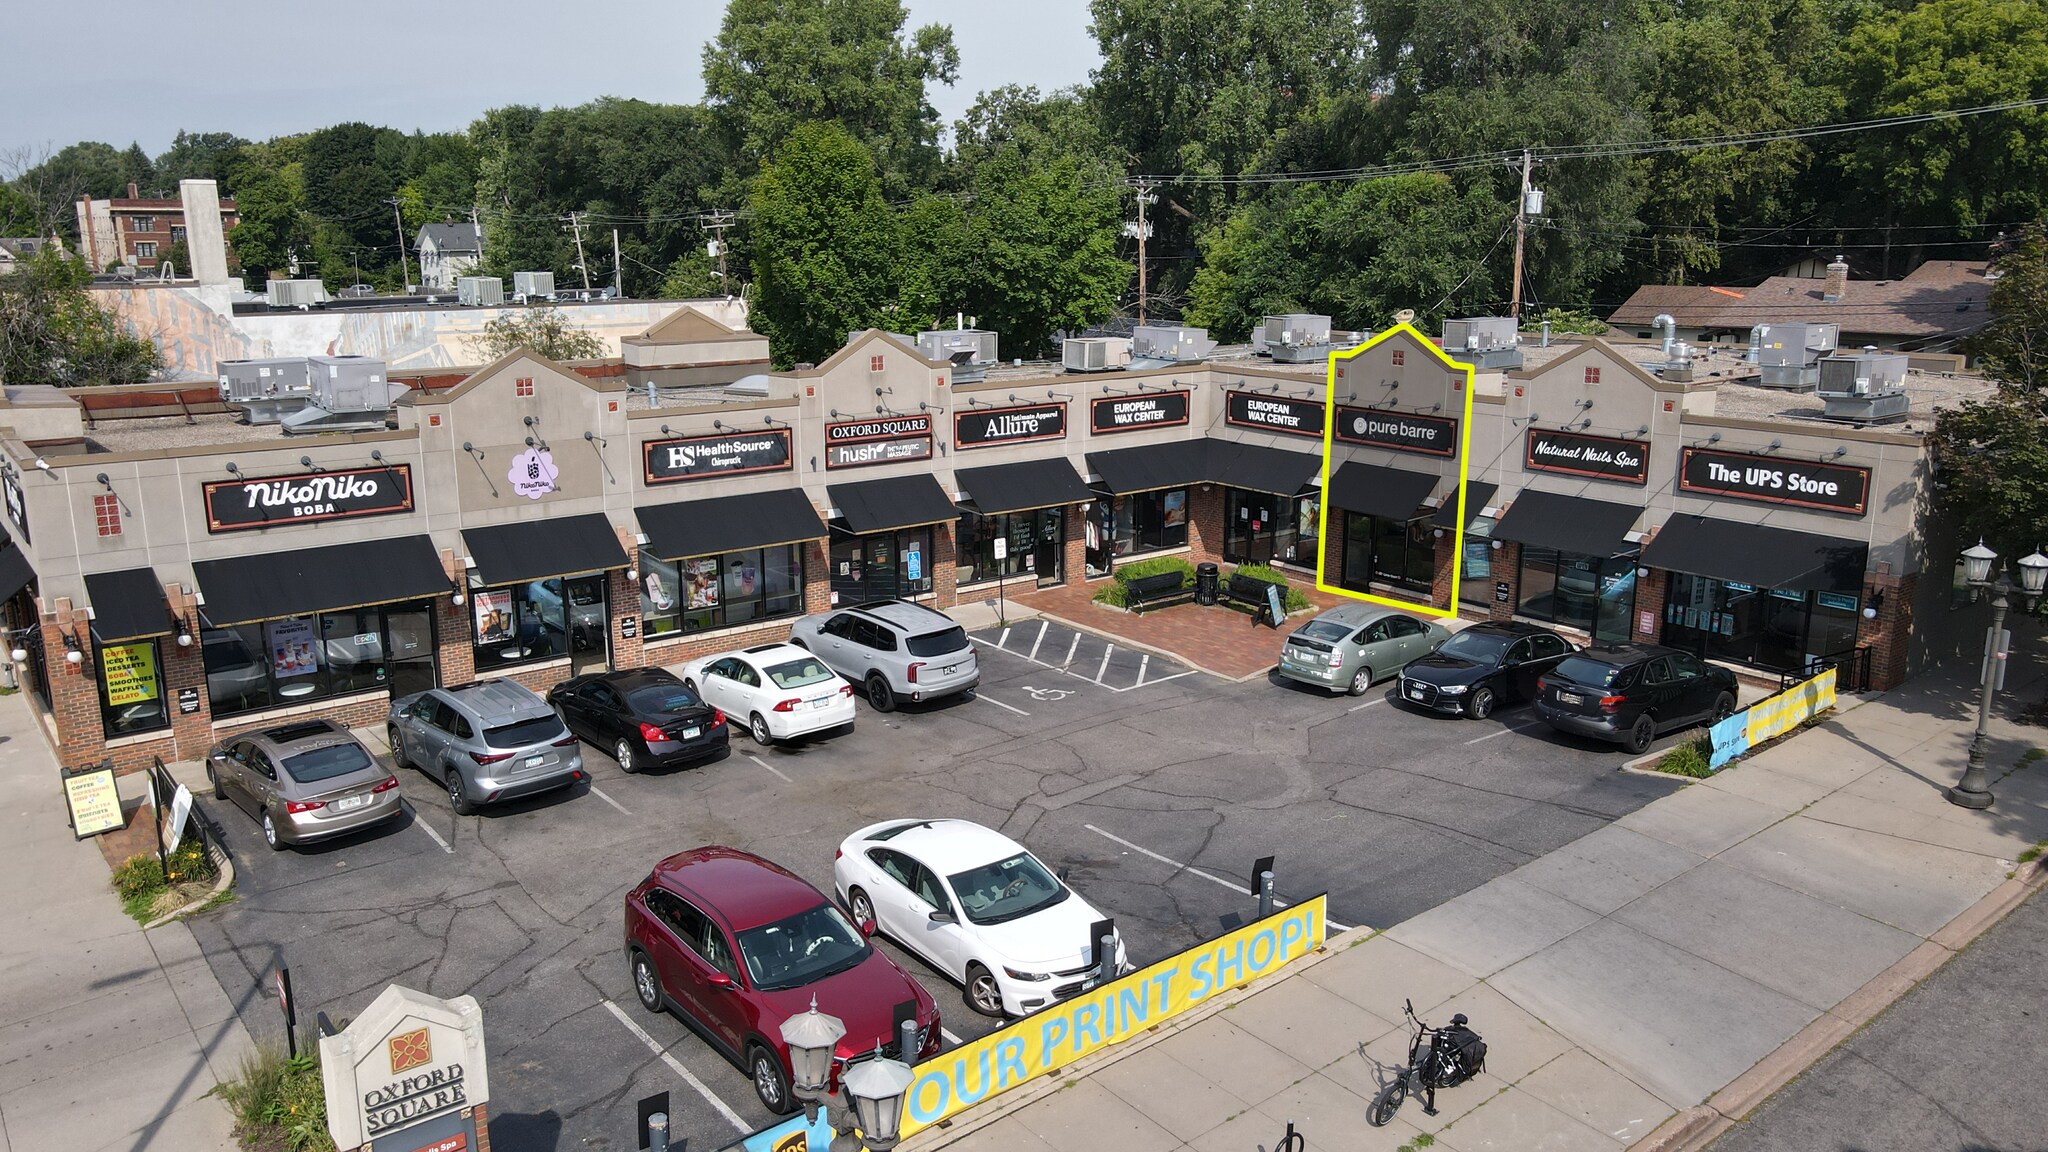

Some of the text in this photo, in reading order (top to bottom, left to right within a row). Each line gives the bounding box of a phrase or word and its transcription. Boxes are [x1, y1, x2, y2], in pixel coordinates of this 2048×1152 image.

[1114, 400, 1156, 414] EUROPEAN
[1248, 400, 1289, 414] EUROPEAN
[1036, 411, 1058, 420] Apparel
[1114, 410, 1164, 424] WAX CENTER
[1248, 411, 1299, 427] WAX CENTER
[833, 419, 926, 438] OXFORD SQUARE
[984, 416, 1039, 437] Allure
[1369, 421, 1435, 440] pure barre
[696, 441, 772, 457] HealthSource
[840, 445, 877, 463] hush
[887, 450, 912, 458] MASSAGE
[1535, 441, 1639, 468] Natural Nails Spa
[667, 445, 695, 469] HS
[711, 456, 741, 467] Chiropractic
[1708, 463, 1838, 496] The UPS Store
[244, 475, 378, 508] NikoNiko
[293, 503, 335, 516] BOBA
[275, 625, 308, 635] FAVORITES
[105, 648, 135, 658] COFFEE
[107, 661, 146, 672] DESSERTS
[108, 671, 128, 680] BOBA
[109, 675, 154, 687] SMOOTHIES
[110, 684, 145, 694] WAFFLES
[111, 692, 140, 702] GELATO
[71, 782, 94, 791] COFFEE
[1041, 967, 1179, 1068] PRINT
[1189, 910, 1315, 999] SHOP!
[364, 1063, 464, 1109] OXFORD
[366, 1084, 466, 1132] SQUARE
[440, 1141, 457, 1151] Spa
